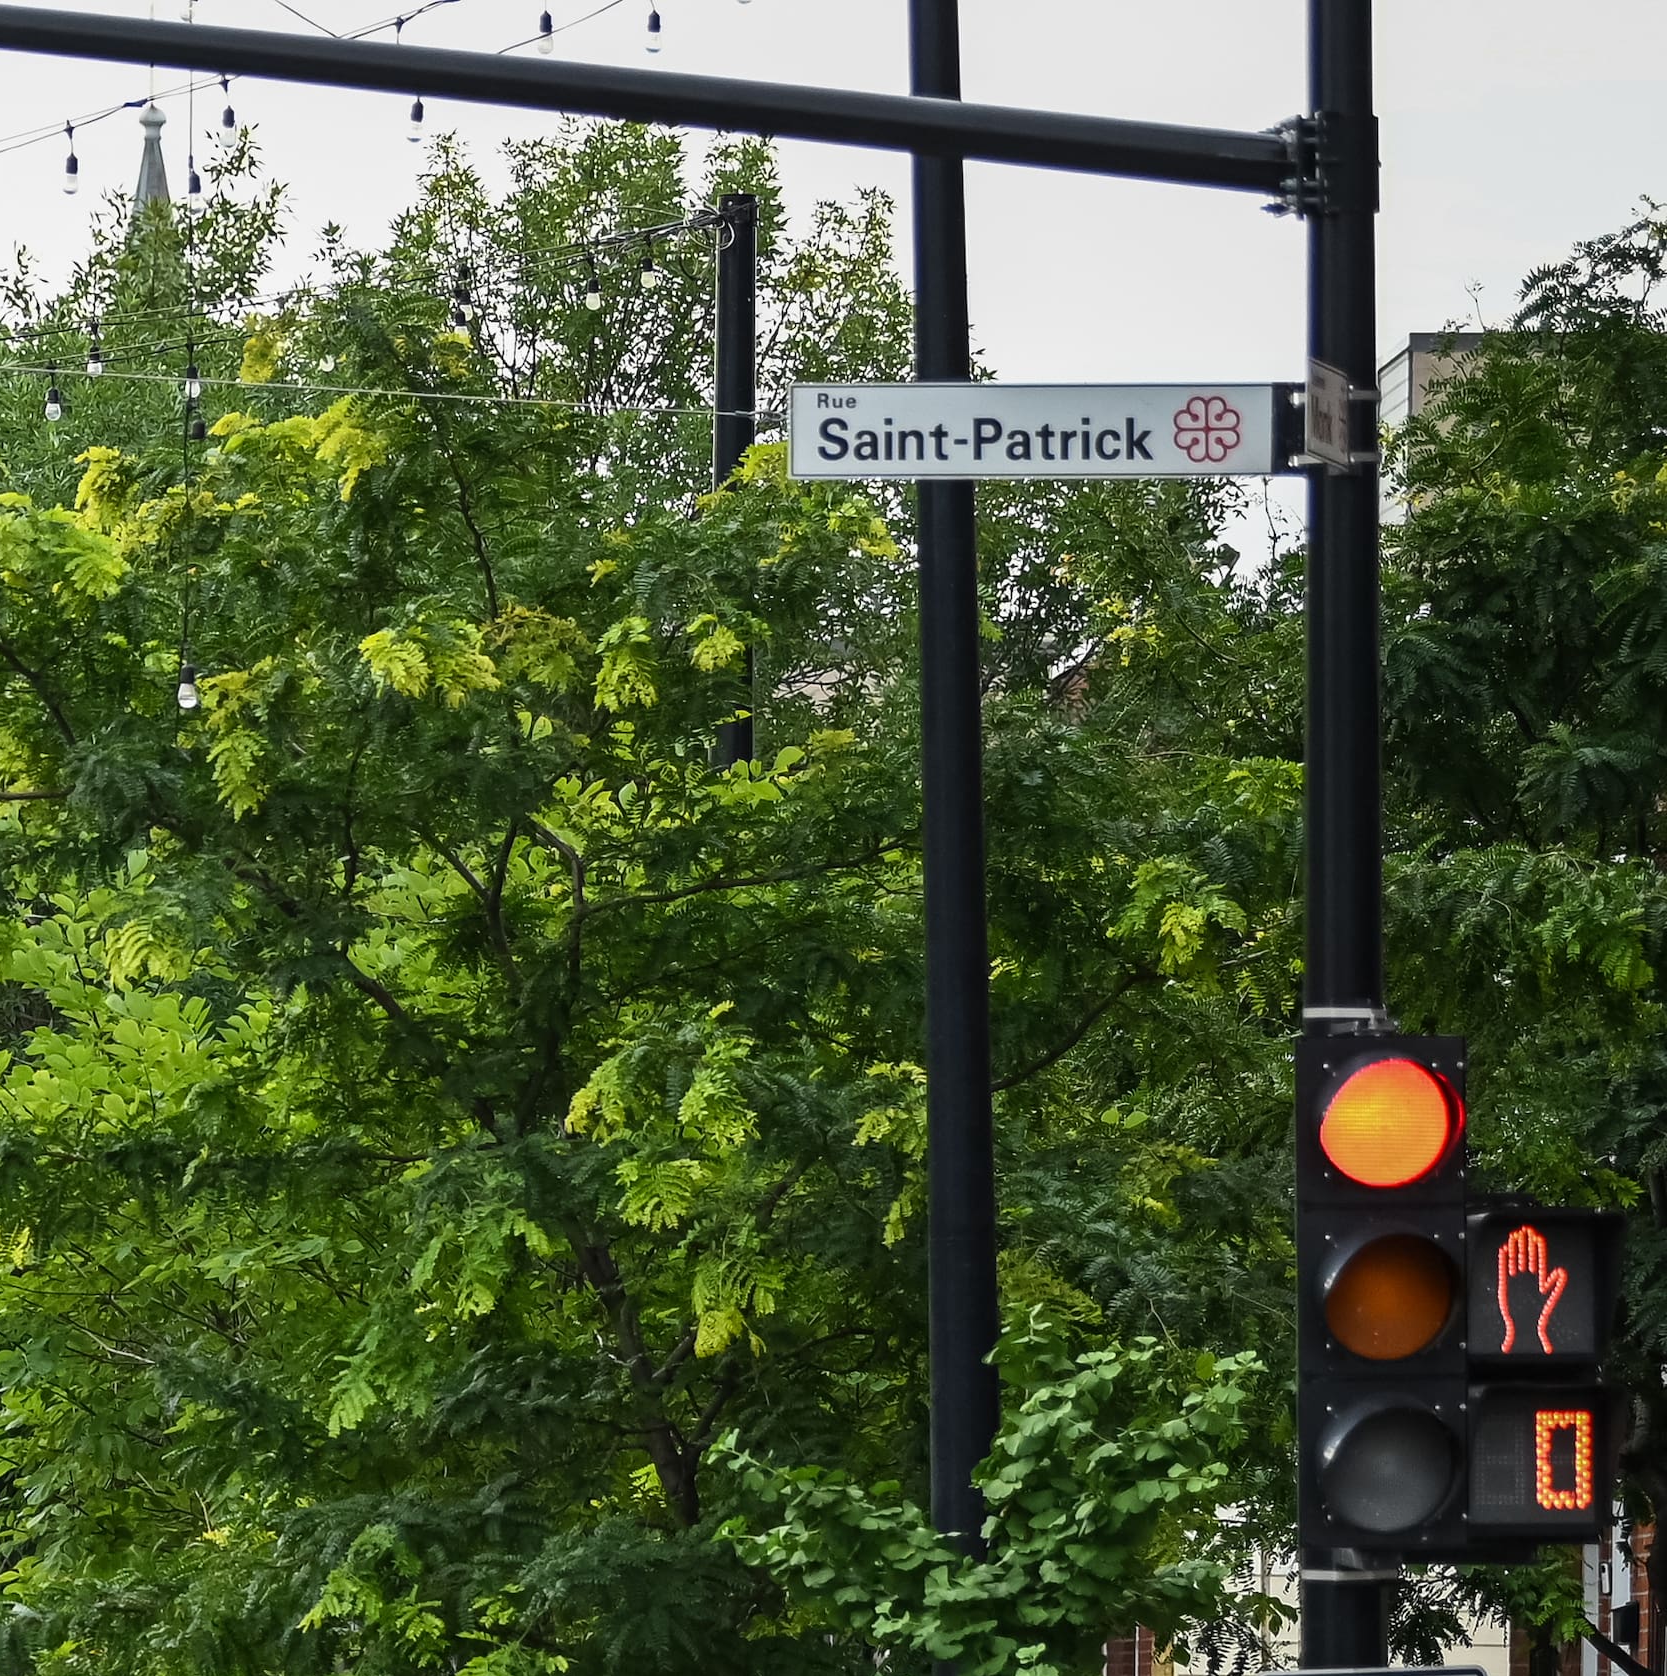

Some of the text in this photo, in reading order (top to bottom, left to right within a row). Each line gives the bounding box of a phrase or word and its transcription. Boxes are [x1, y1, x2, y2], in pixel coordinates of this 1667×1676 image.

[817, 393, 857, 409] Rue
[817, 416, 1153, 462] Saint-Patrick
[1535, 1410, 1593, 1509] 0
